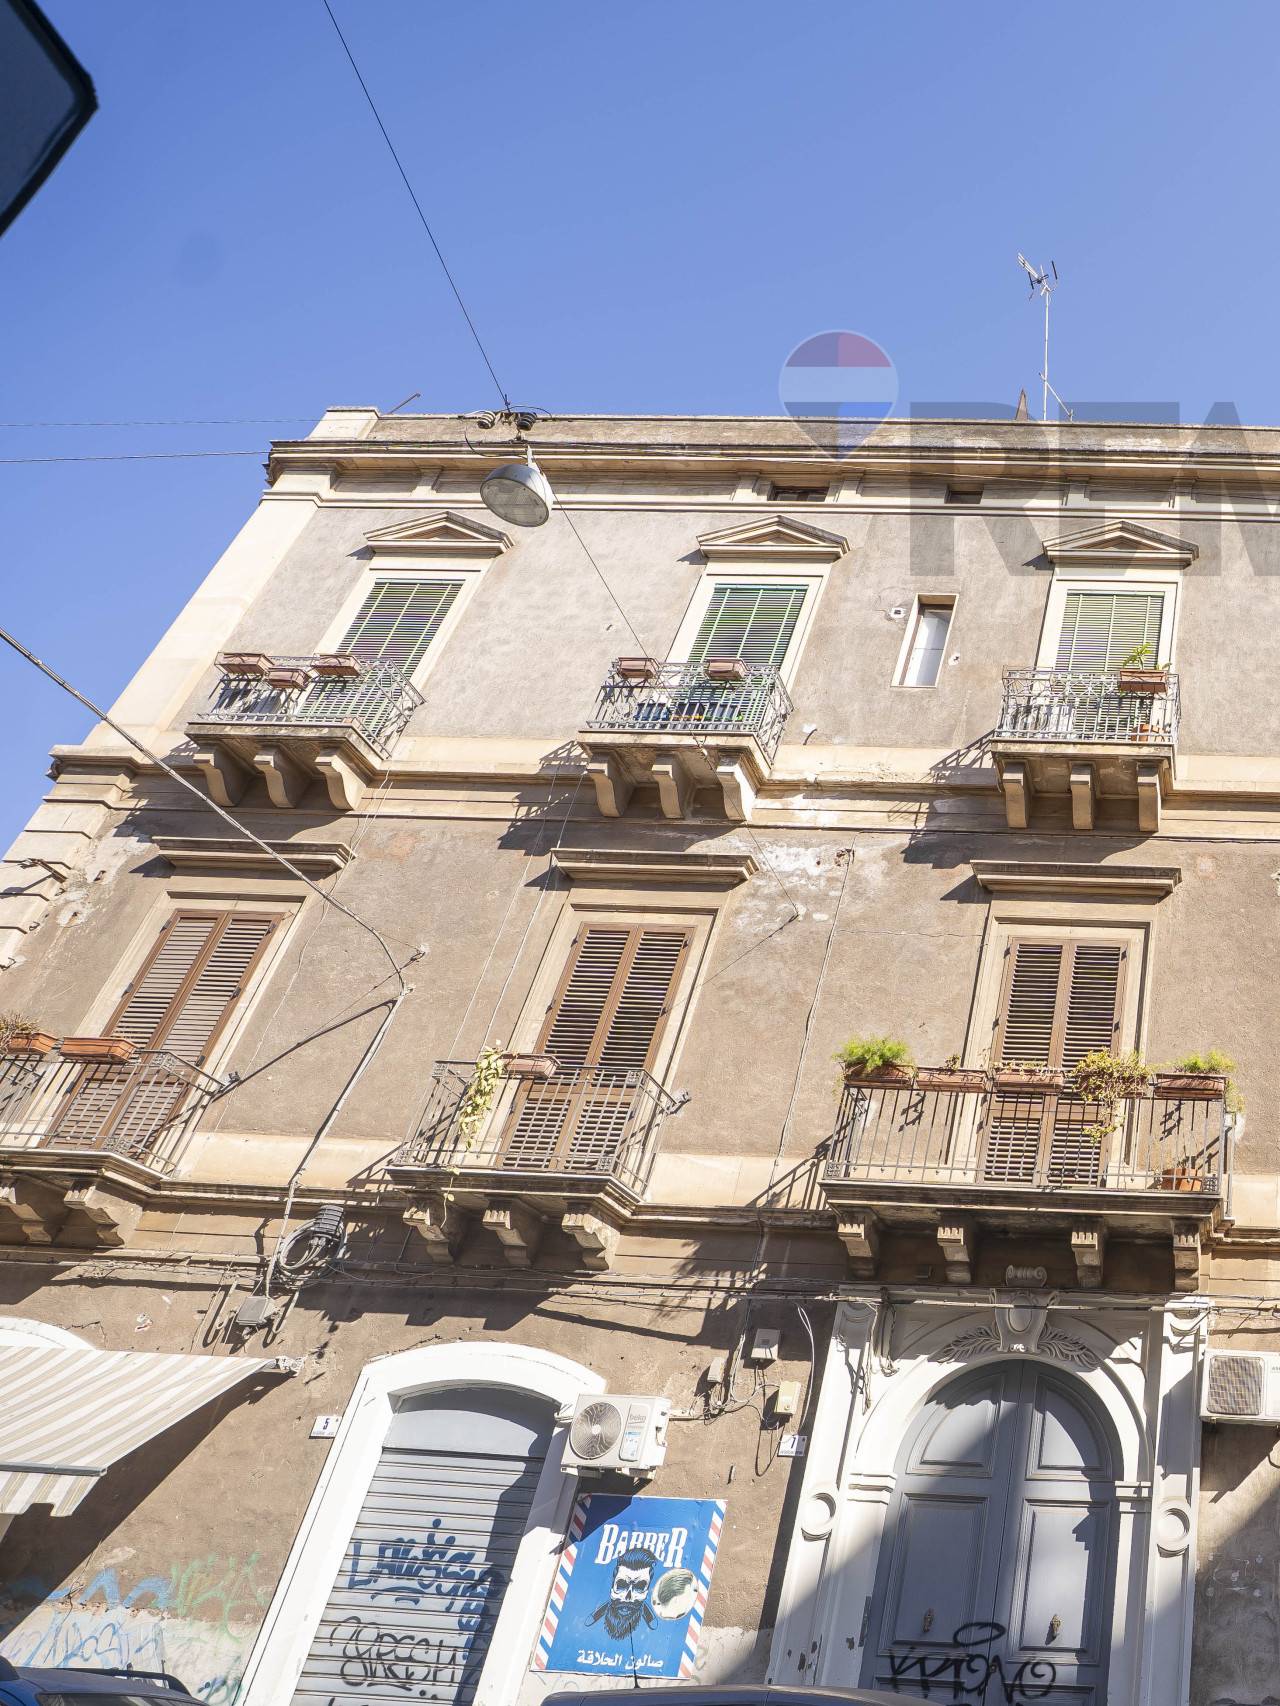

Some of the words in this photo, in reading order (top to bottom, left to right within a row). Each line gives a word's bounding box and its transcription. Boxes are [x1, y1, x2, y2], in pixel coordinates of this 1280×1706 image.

[322, 1417, 330, 1430] 5
[595, 1524, 688, 1568] BARBER
[576, 1648, 623, 1667] الحلاقة
[625, 1653, 664, 1670] صالون
